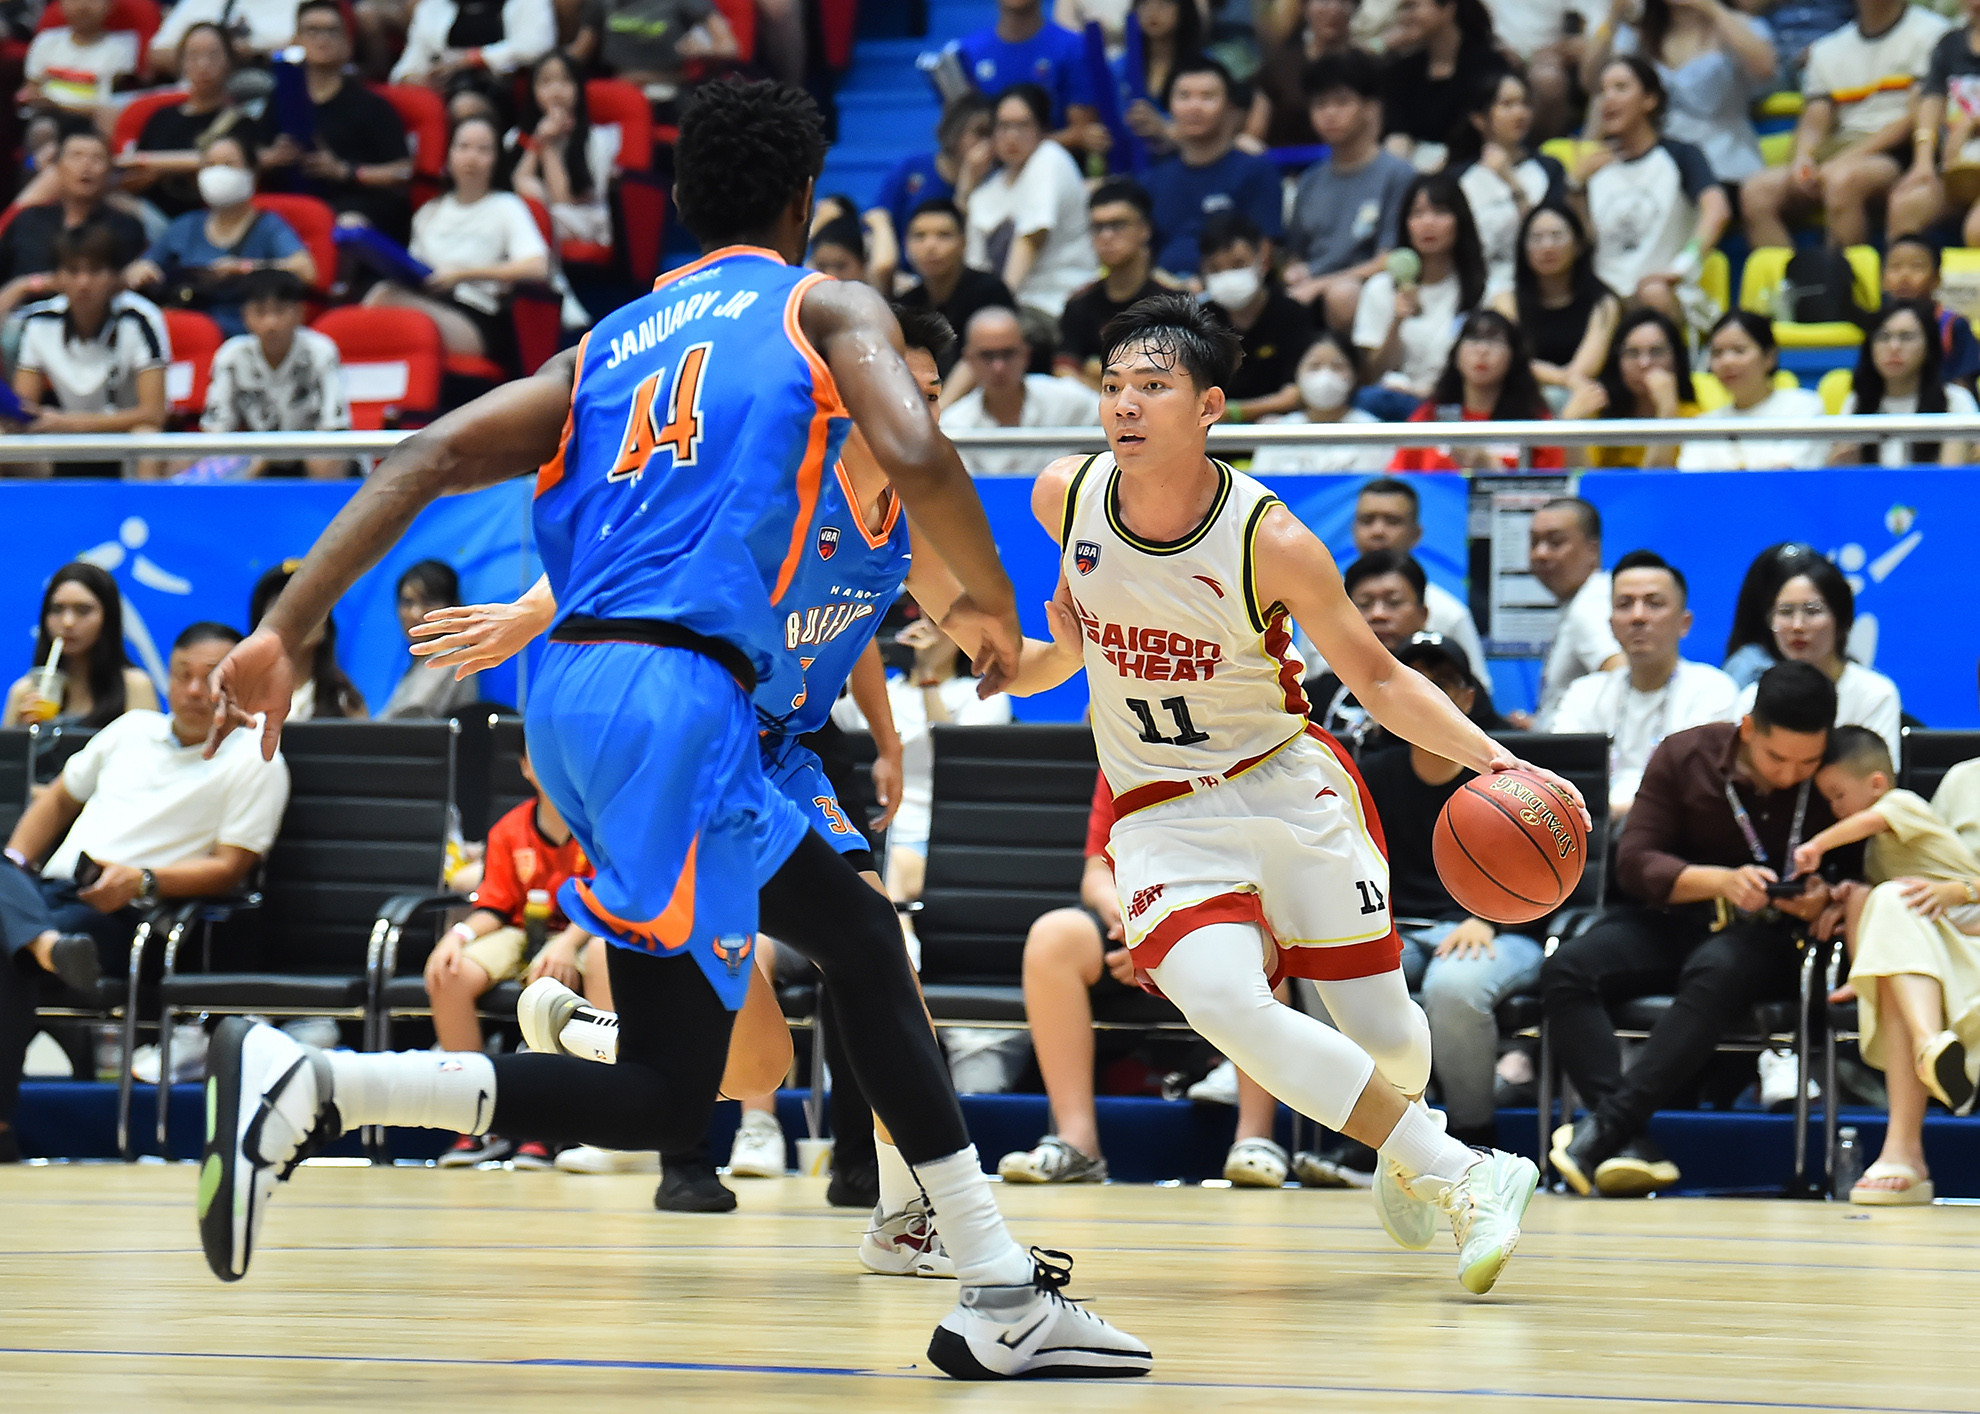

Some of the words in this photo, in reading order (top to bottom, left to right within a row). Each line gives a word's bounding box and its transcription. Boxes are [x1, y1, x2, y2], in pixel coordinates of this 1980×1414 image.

[606, 290, 722, 369] JANUARY
[712, 290, 759, 320] JR
[606, 341, 714, 484] 44
[820, 530, 837, 542] VBA
[1077, 544, 1097, 558] VBA
[1102, 650, 1223, 682] HEAT
[1125, 695, 1211, 746] 11
[1490, 774, 1577, 859] SPALDING
[1127, 885, 1164, 921] HEAT
[1355, 880, 1386, 915] 11
